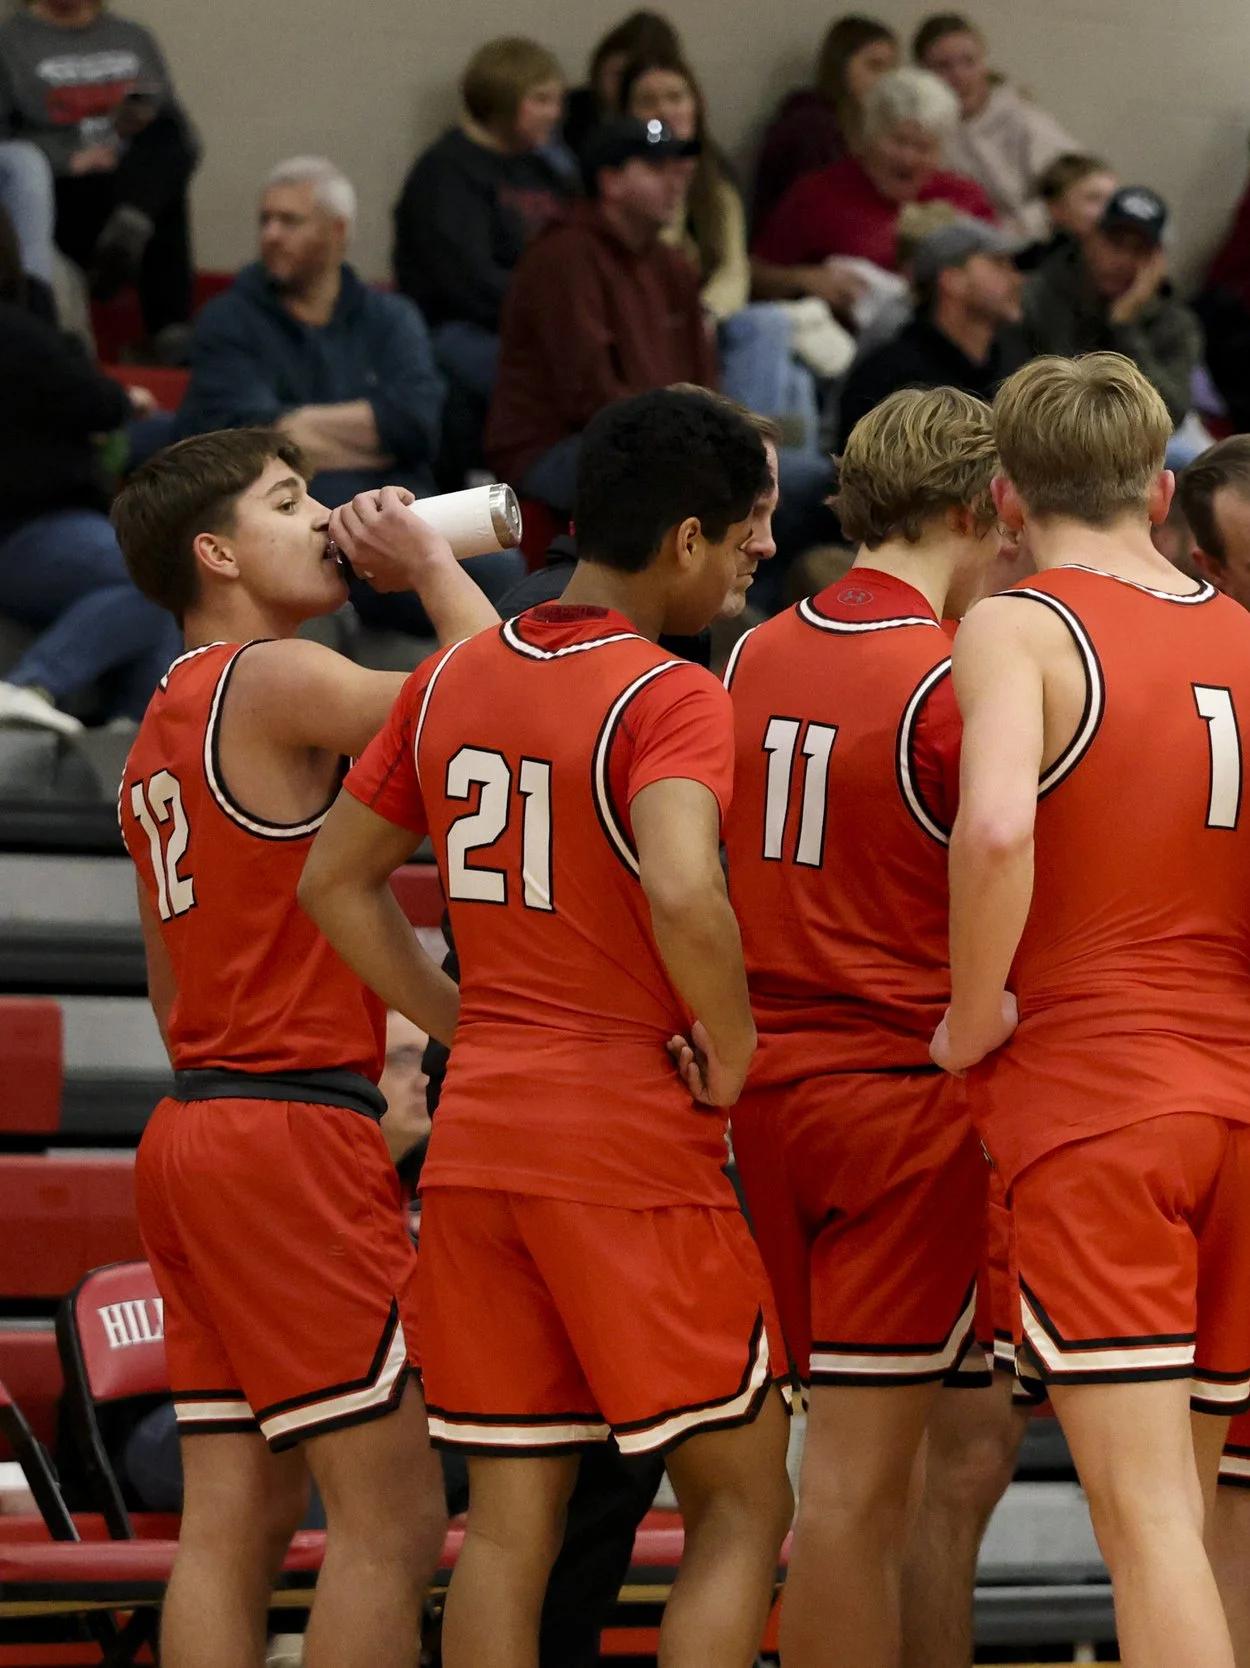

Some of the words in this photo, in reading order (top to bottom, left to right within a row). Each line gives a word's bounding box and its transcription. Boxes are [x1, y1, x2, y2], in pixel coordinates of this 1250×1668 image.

[446, 743, 556, 913] 21
[761, 714, 839, 869] 11
[1190, 682, 1243, 831] 1
[130, 768, 197, 923] 12
